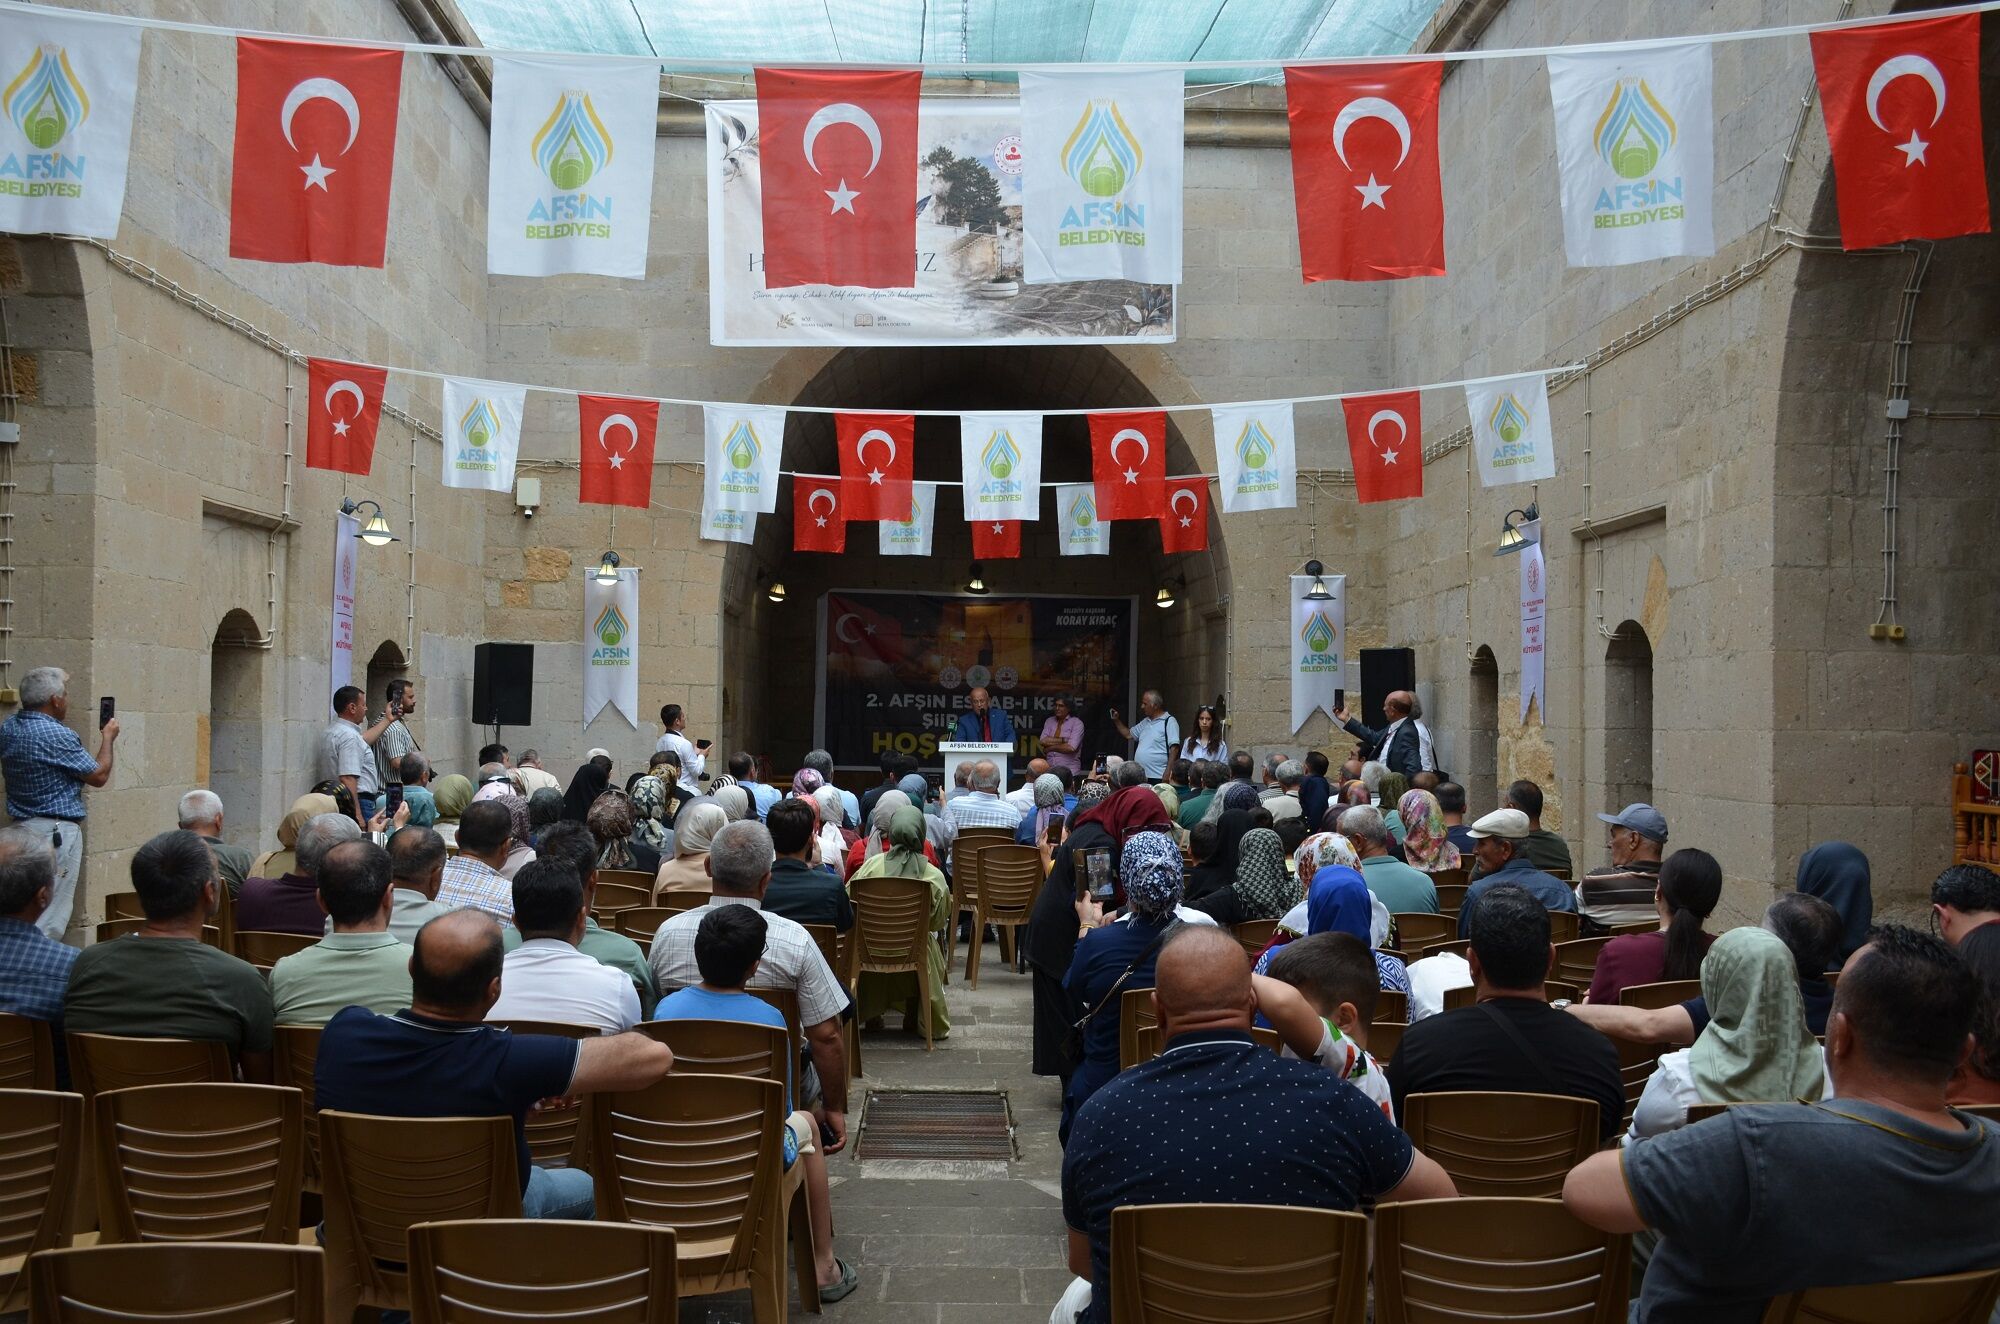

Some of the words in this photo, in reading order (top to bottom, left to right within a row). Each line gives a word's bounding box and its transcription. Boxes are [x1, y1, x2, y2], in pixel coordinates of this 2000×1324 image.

[1056, 615, 1088, 626] KORAY
[1089, 615, 1118, 628] KIRAÇ
[866, 693, 883, 707] 2.
[889, 694, 946, 711] AFŞİN
[952, 695, 1028, 710] ESAB-I
[1033, 696, 1084, 710] KEF
